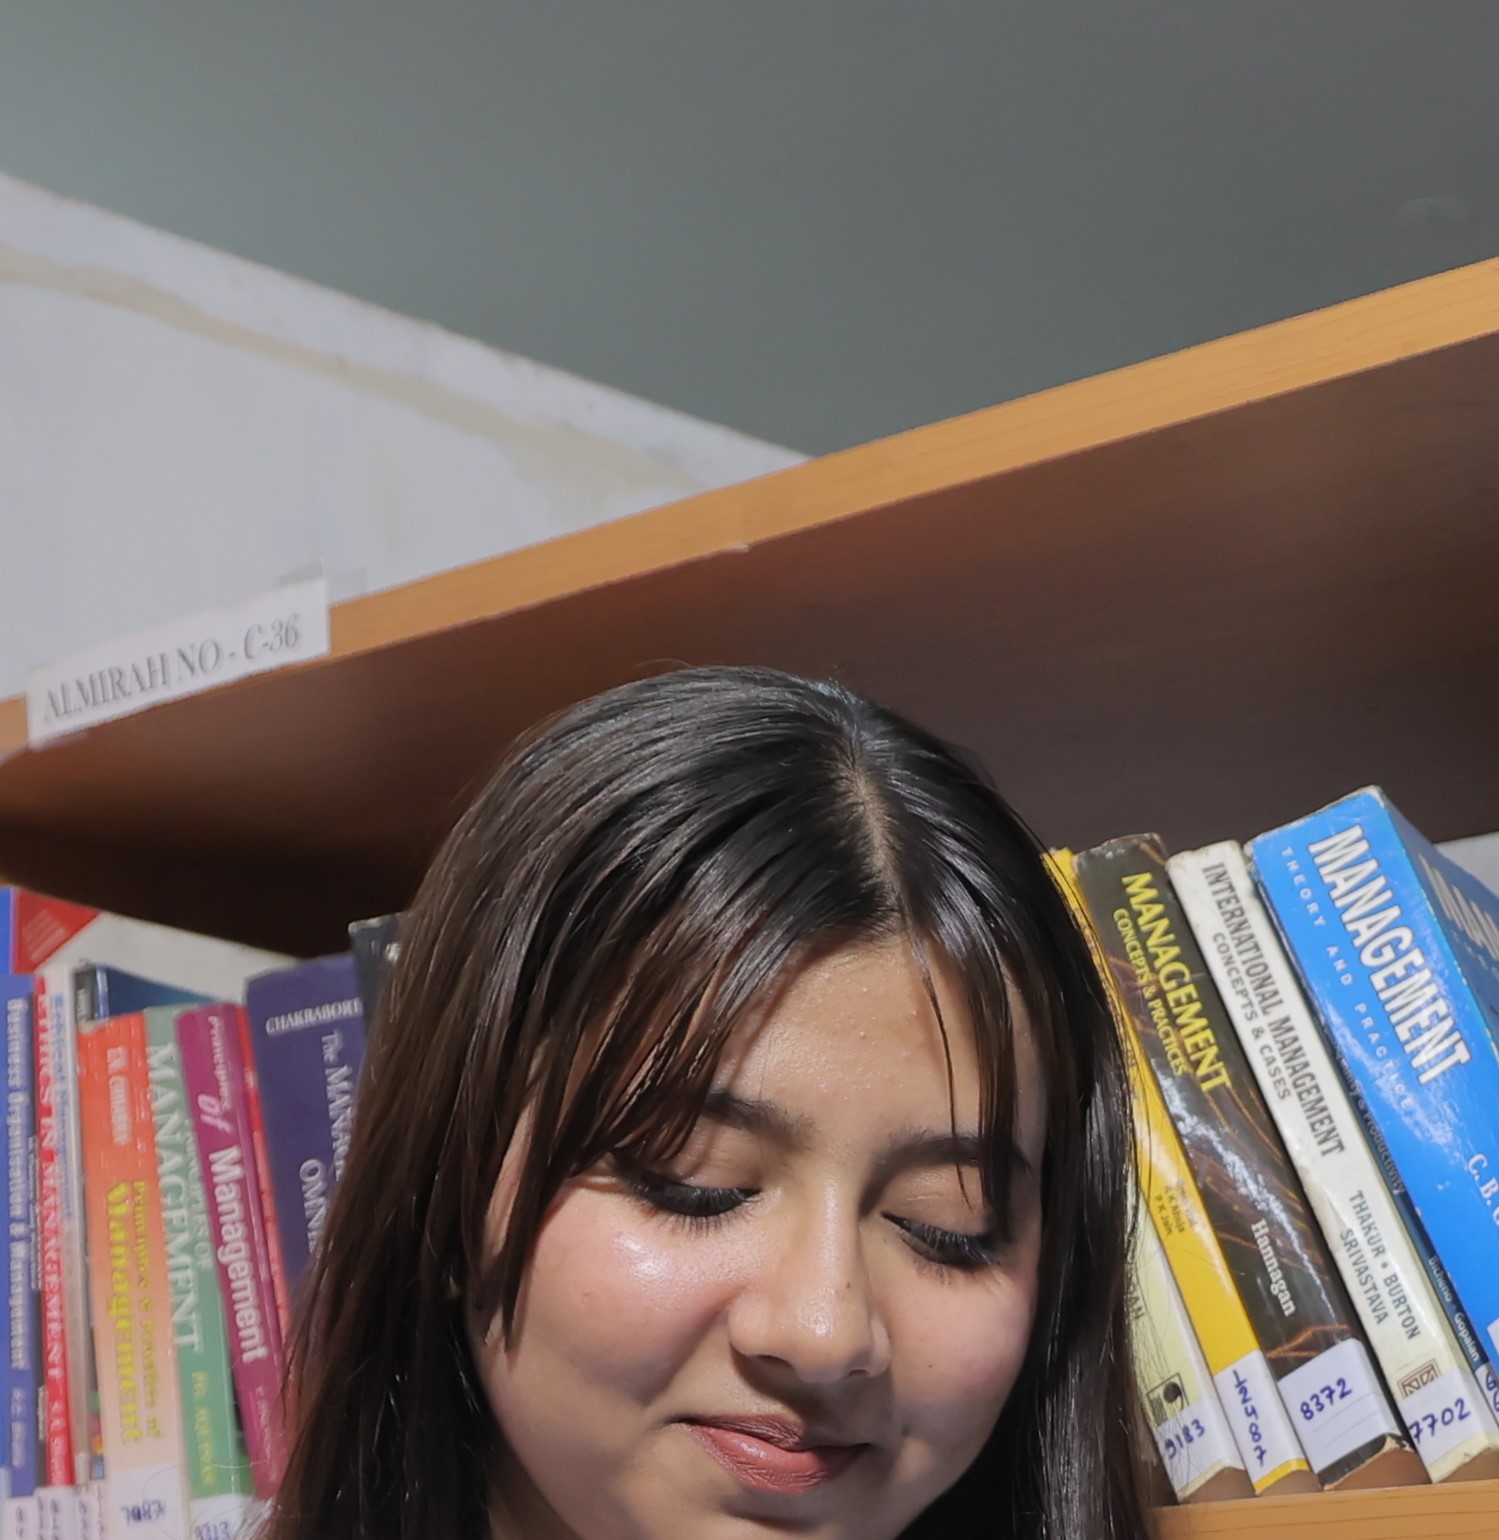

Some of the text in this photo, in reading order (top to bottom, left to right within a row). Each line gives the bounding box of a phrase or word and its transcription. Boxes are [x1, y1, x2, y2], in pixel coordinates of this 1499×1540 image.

[42, 613, 300, 722] ALMIRAH NO C-36
[1120, 872, 1232, 1096] MANAGEMENT
[1281, 846, 1326, 928] THEORY
[1326, 944, 1354, 990] AND
[1310, 824, 1471, 1086] MANAGEMENT
[265, 998, 362, 1035] CHAKRABORT
[321, 1029, 344, 1064] The
[1110, 905, 1191, 1079] CONCEPTS & PRACTICES
[1201, 859, 1346, 1160] INTERNATIONAL MANAGEMENT
[1210, 929, 1292, 1101] CONCEPTS & CASES
[40, 1116, 58, 1150] IN
[147, 1043, 199, 1350] MANAGEMENT
[1464, 1151, 1492, 1182] C.
[9, 1240, 30, 1370] Management
[42, 1161, 65, 1378] MANAGEMENT
[107, 1182, 144, 1443] Management
[208, 1145, 270, 1363] Management
[1248, 1216, 1299, 1317] Hannagan
[1338, 1227, 1391, 1325] SRIVASTAVA
[1348, 1189, 1421, 1340] THAKUR BURTON
[1299, 1377, 1353, 1422] 8372
[1452, 1310, 1483, 1362] Gopalan
[1408, 1397, 1472, 1446] 7702
